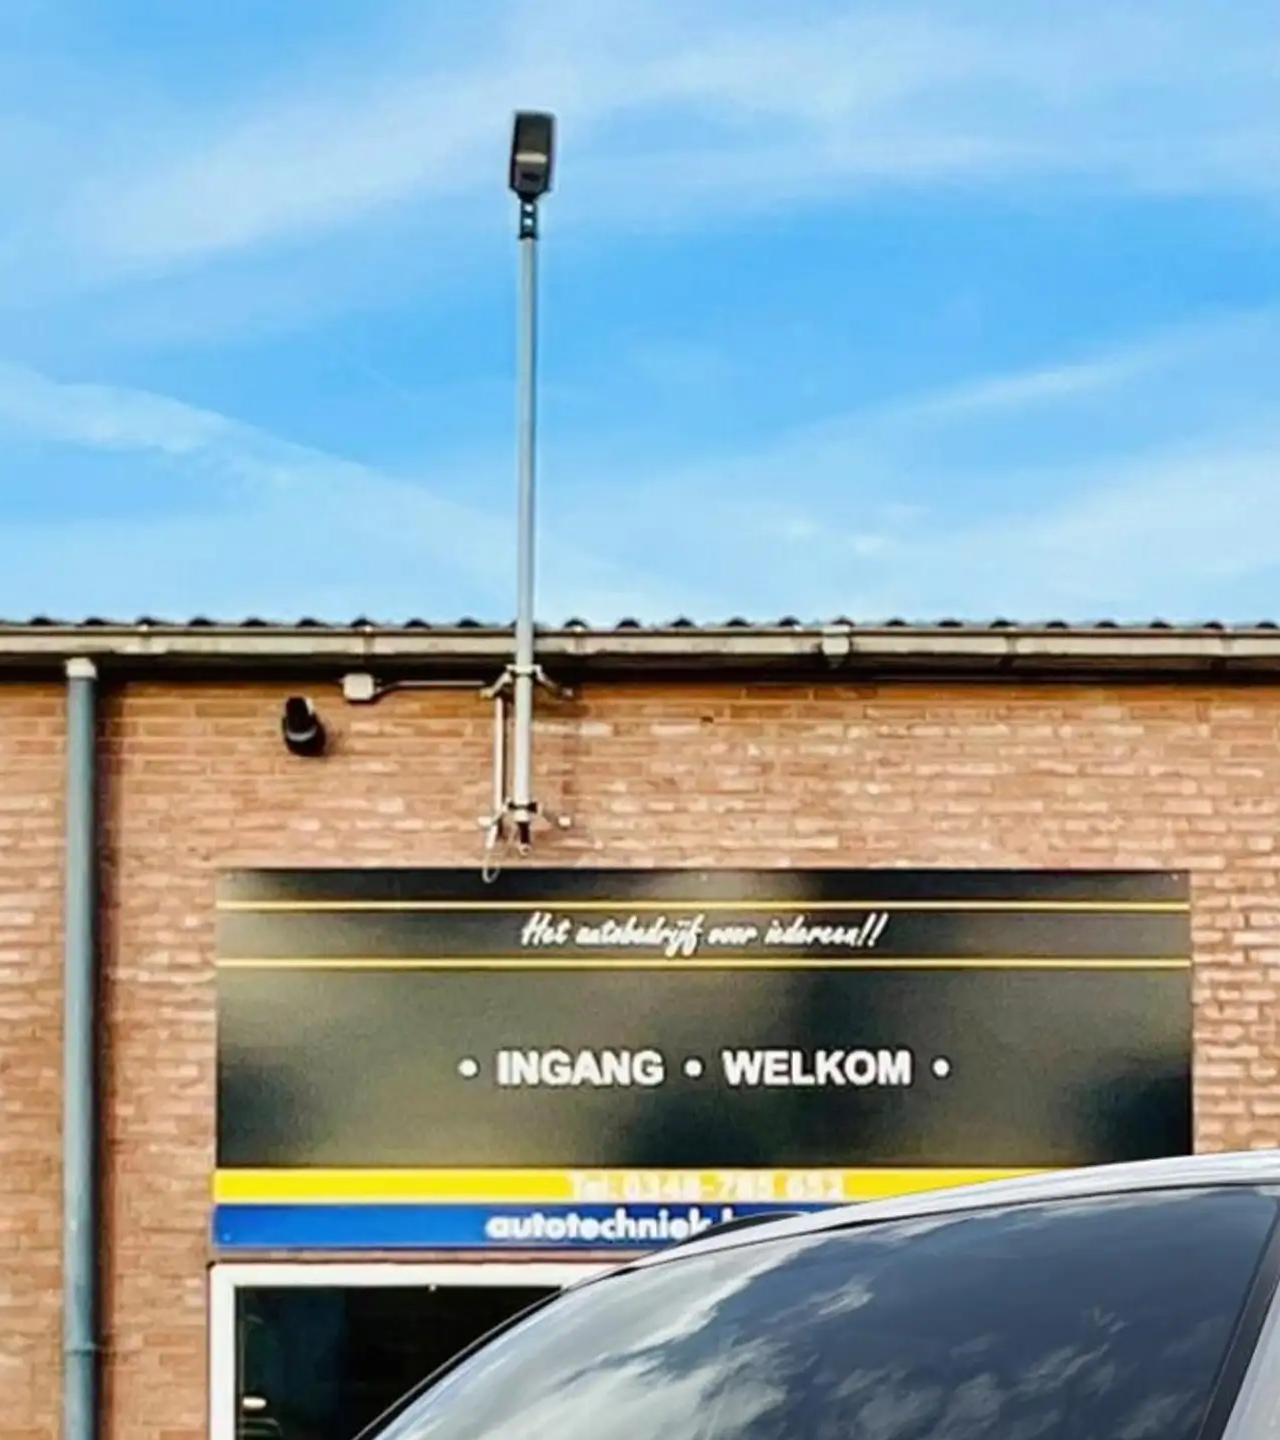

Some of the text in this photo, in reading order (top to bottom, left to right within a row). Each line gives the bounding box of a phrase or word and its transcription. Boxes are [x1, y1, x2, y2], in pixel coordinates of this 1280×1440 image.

[521, 911, 570, 946] Het
[575, 913, 705, 957] autobedrijf
[764, 912, 889, 947] iedereen!!
[497, 1049, 911, 1086] INGANG WELKOM
